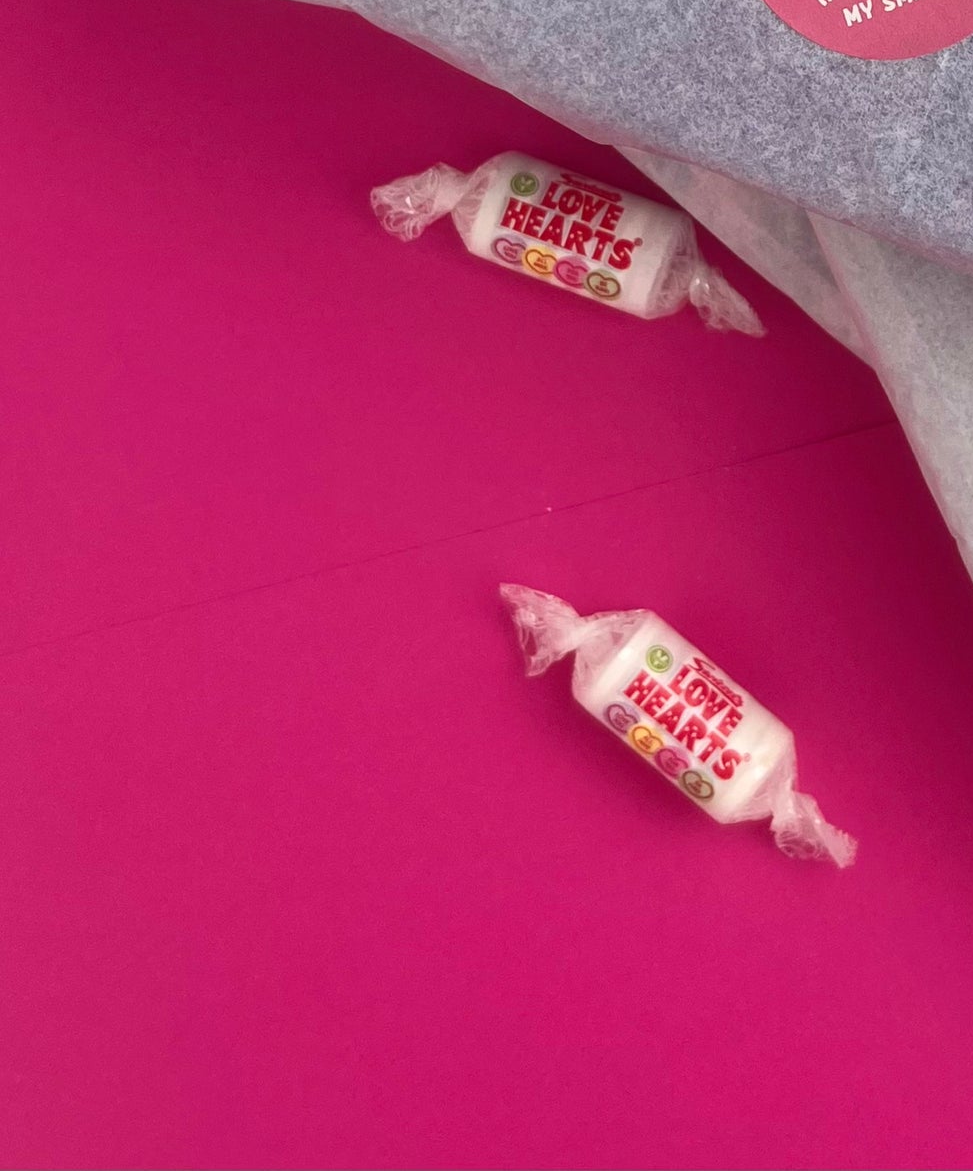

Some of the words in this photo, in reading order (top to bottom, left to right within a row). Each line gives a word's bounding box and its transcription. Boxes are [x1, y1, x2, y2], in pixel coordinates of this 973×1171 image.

[843, 0, 873, 27] MY
[500, 196, 634, 270] HEARTS
[540, 181, 625, 232] LOVE
[623, 669, 742, 781] HEARTS
[667, 665, 743, 738] LOVE
